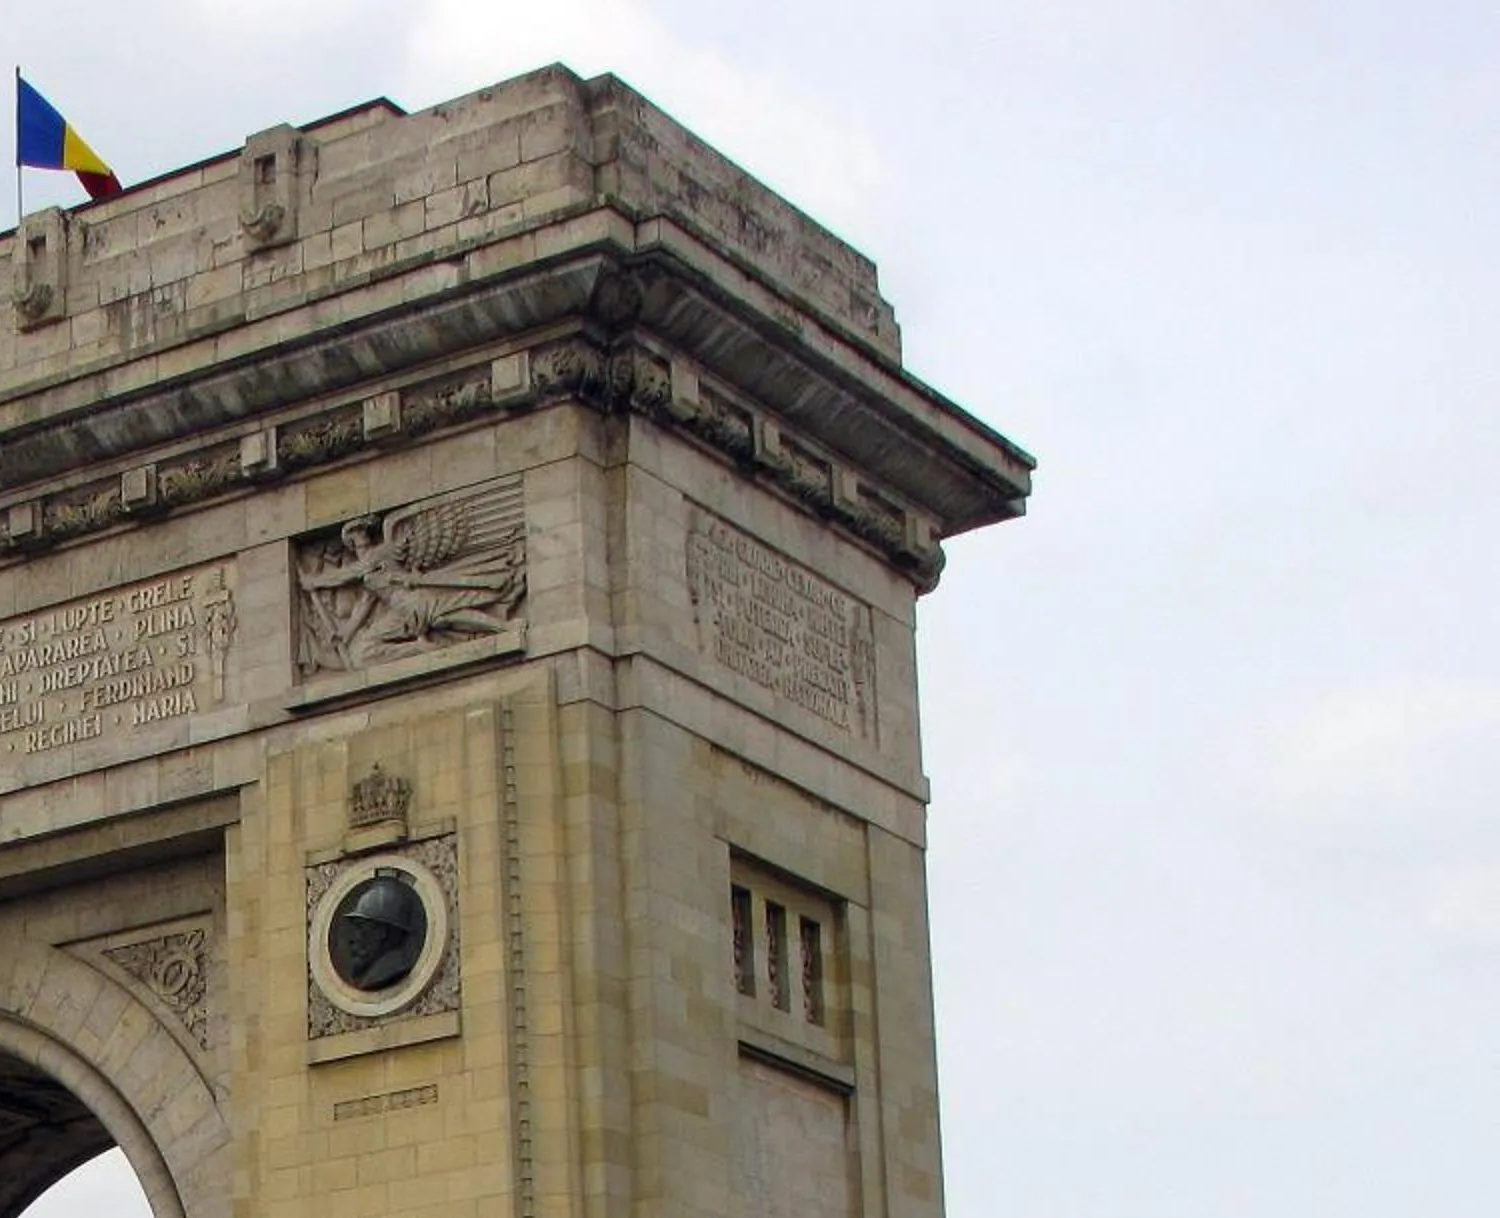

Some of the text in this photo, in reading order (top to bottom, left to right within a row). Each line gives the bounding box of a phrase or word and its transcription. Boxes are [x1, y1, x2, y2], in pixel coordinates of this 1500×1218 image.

[51, 599, 114, 636] LUPTE
[129, 576, 195, 614] GRELE
[1, 627, 108, 678] APARAREA
[134, 602, 196, 641] PLINA
[39, 646, 153, 695] DREPTATEA
[80, 662, 195, 713] FERDINAND
[25, 713, 101, 753] REGINEI
[132, 689, 197, 726] MARIA
